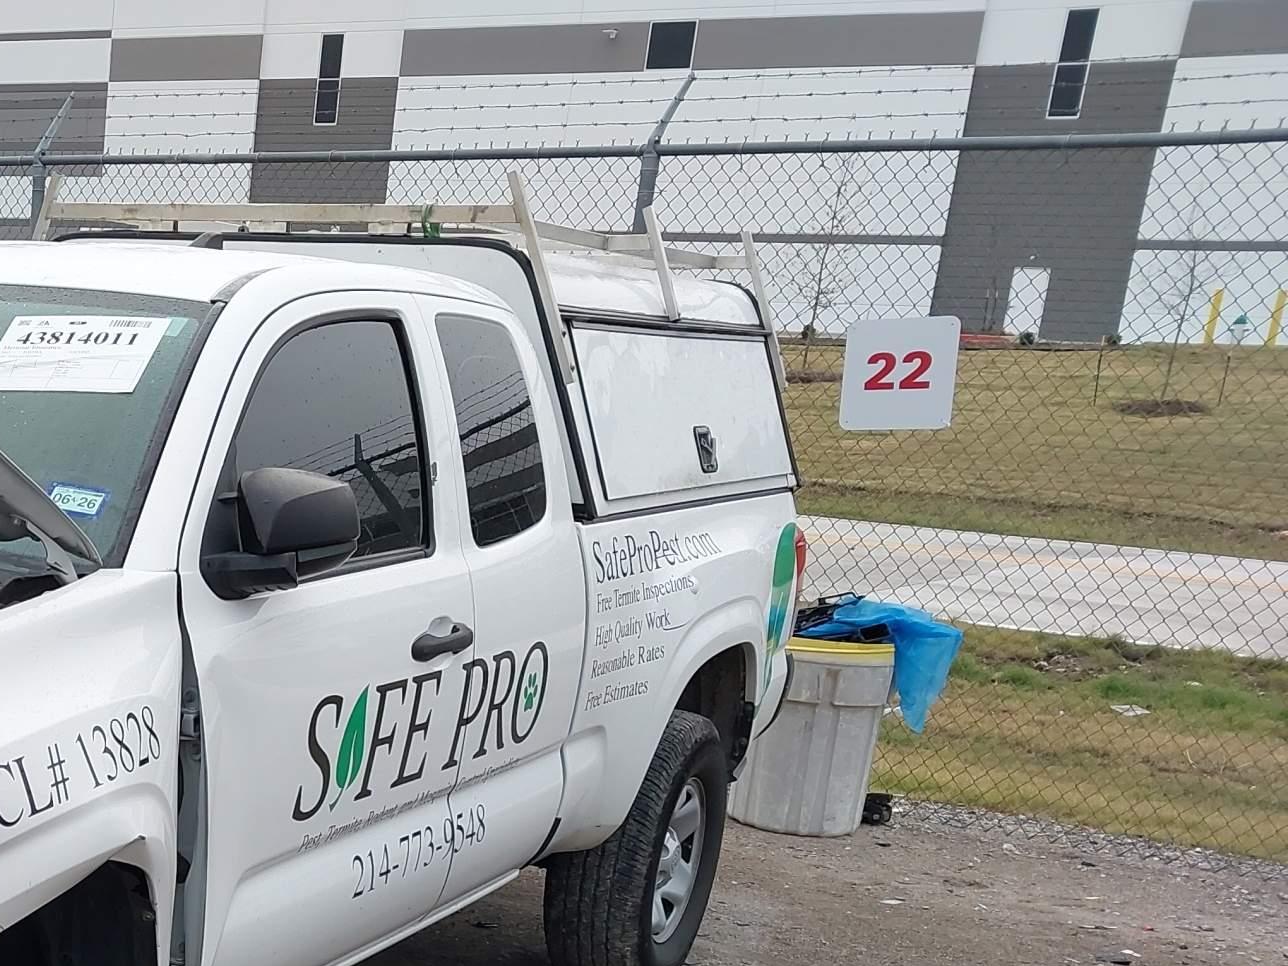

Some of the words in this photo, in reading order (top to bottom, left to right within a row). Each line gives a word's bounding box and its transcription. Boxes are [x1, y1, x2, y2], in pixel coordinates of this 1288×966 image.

[16, 331, 140, 346] 43814011
[863, 350, 933, 391] 22
[77, 497, 98, 509] 26
[592, 530, 722, 584] SafeProPest.com
[596, 593, 613, 613] Free
[614, 585, 641, 609] Termite
[641, 575, 694, 603] Inspections
[595, 624, 613, 649] High
[614, 616, 643, 643] Quality
[645, 609, 671, 631] Work
[591, 649, 635, 680] Reasonable
[638, 645, 665, 665] Rates
[441, 641, 549, 771] PRO
[584, 692, 602, 712] Free
[603, 680, 649, 704] Estimates
[75, 706, 160, 789] 13828
[351, 804, 486, 899] 214-773-9548
